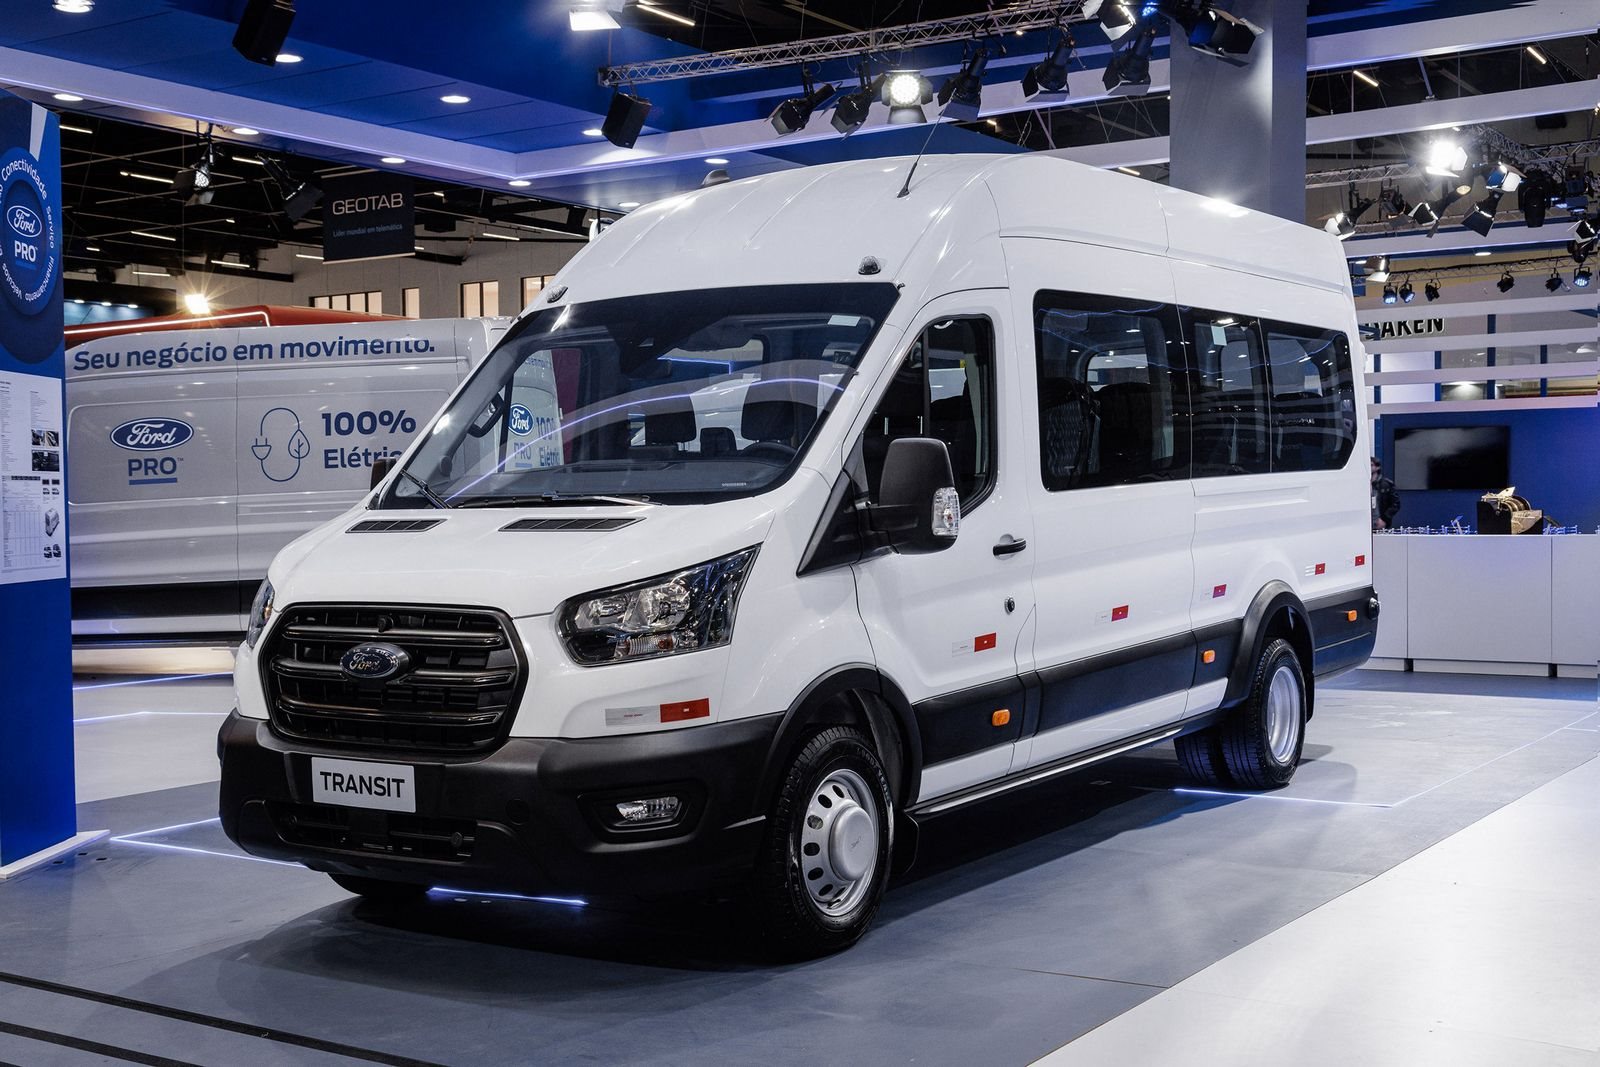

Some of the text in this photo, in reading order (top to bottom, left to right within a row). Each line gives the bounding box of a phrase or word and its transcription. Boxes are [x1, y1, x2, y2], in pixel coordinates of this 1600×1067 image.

[1, 159, 47, 200] Conectividade
[332, 192, 404, 215] GEOTAB
[14, 240, 37, 262] PRO
[73, 350, 120, 371] Seu
[126, 342, 227, 369] negócio
[233, 342, 273, 361] em
[126, 423, 177, 446] Ford
[321, 409, 417, 437] 100%
[513, 441, 532, 460] PRO
[127, 456, 177, 477] PRO
[319, 770, 406, 799] TRANSIT
